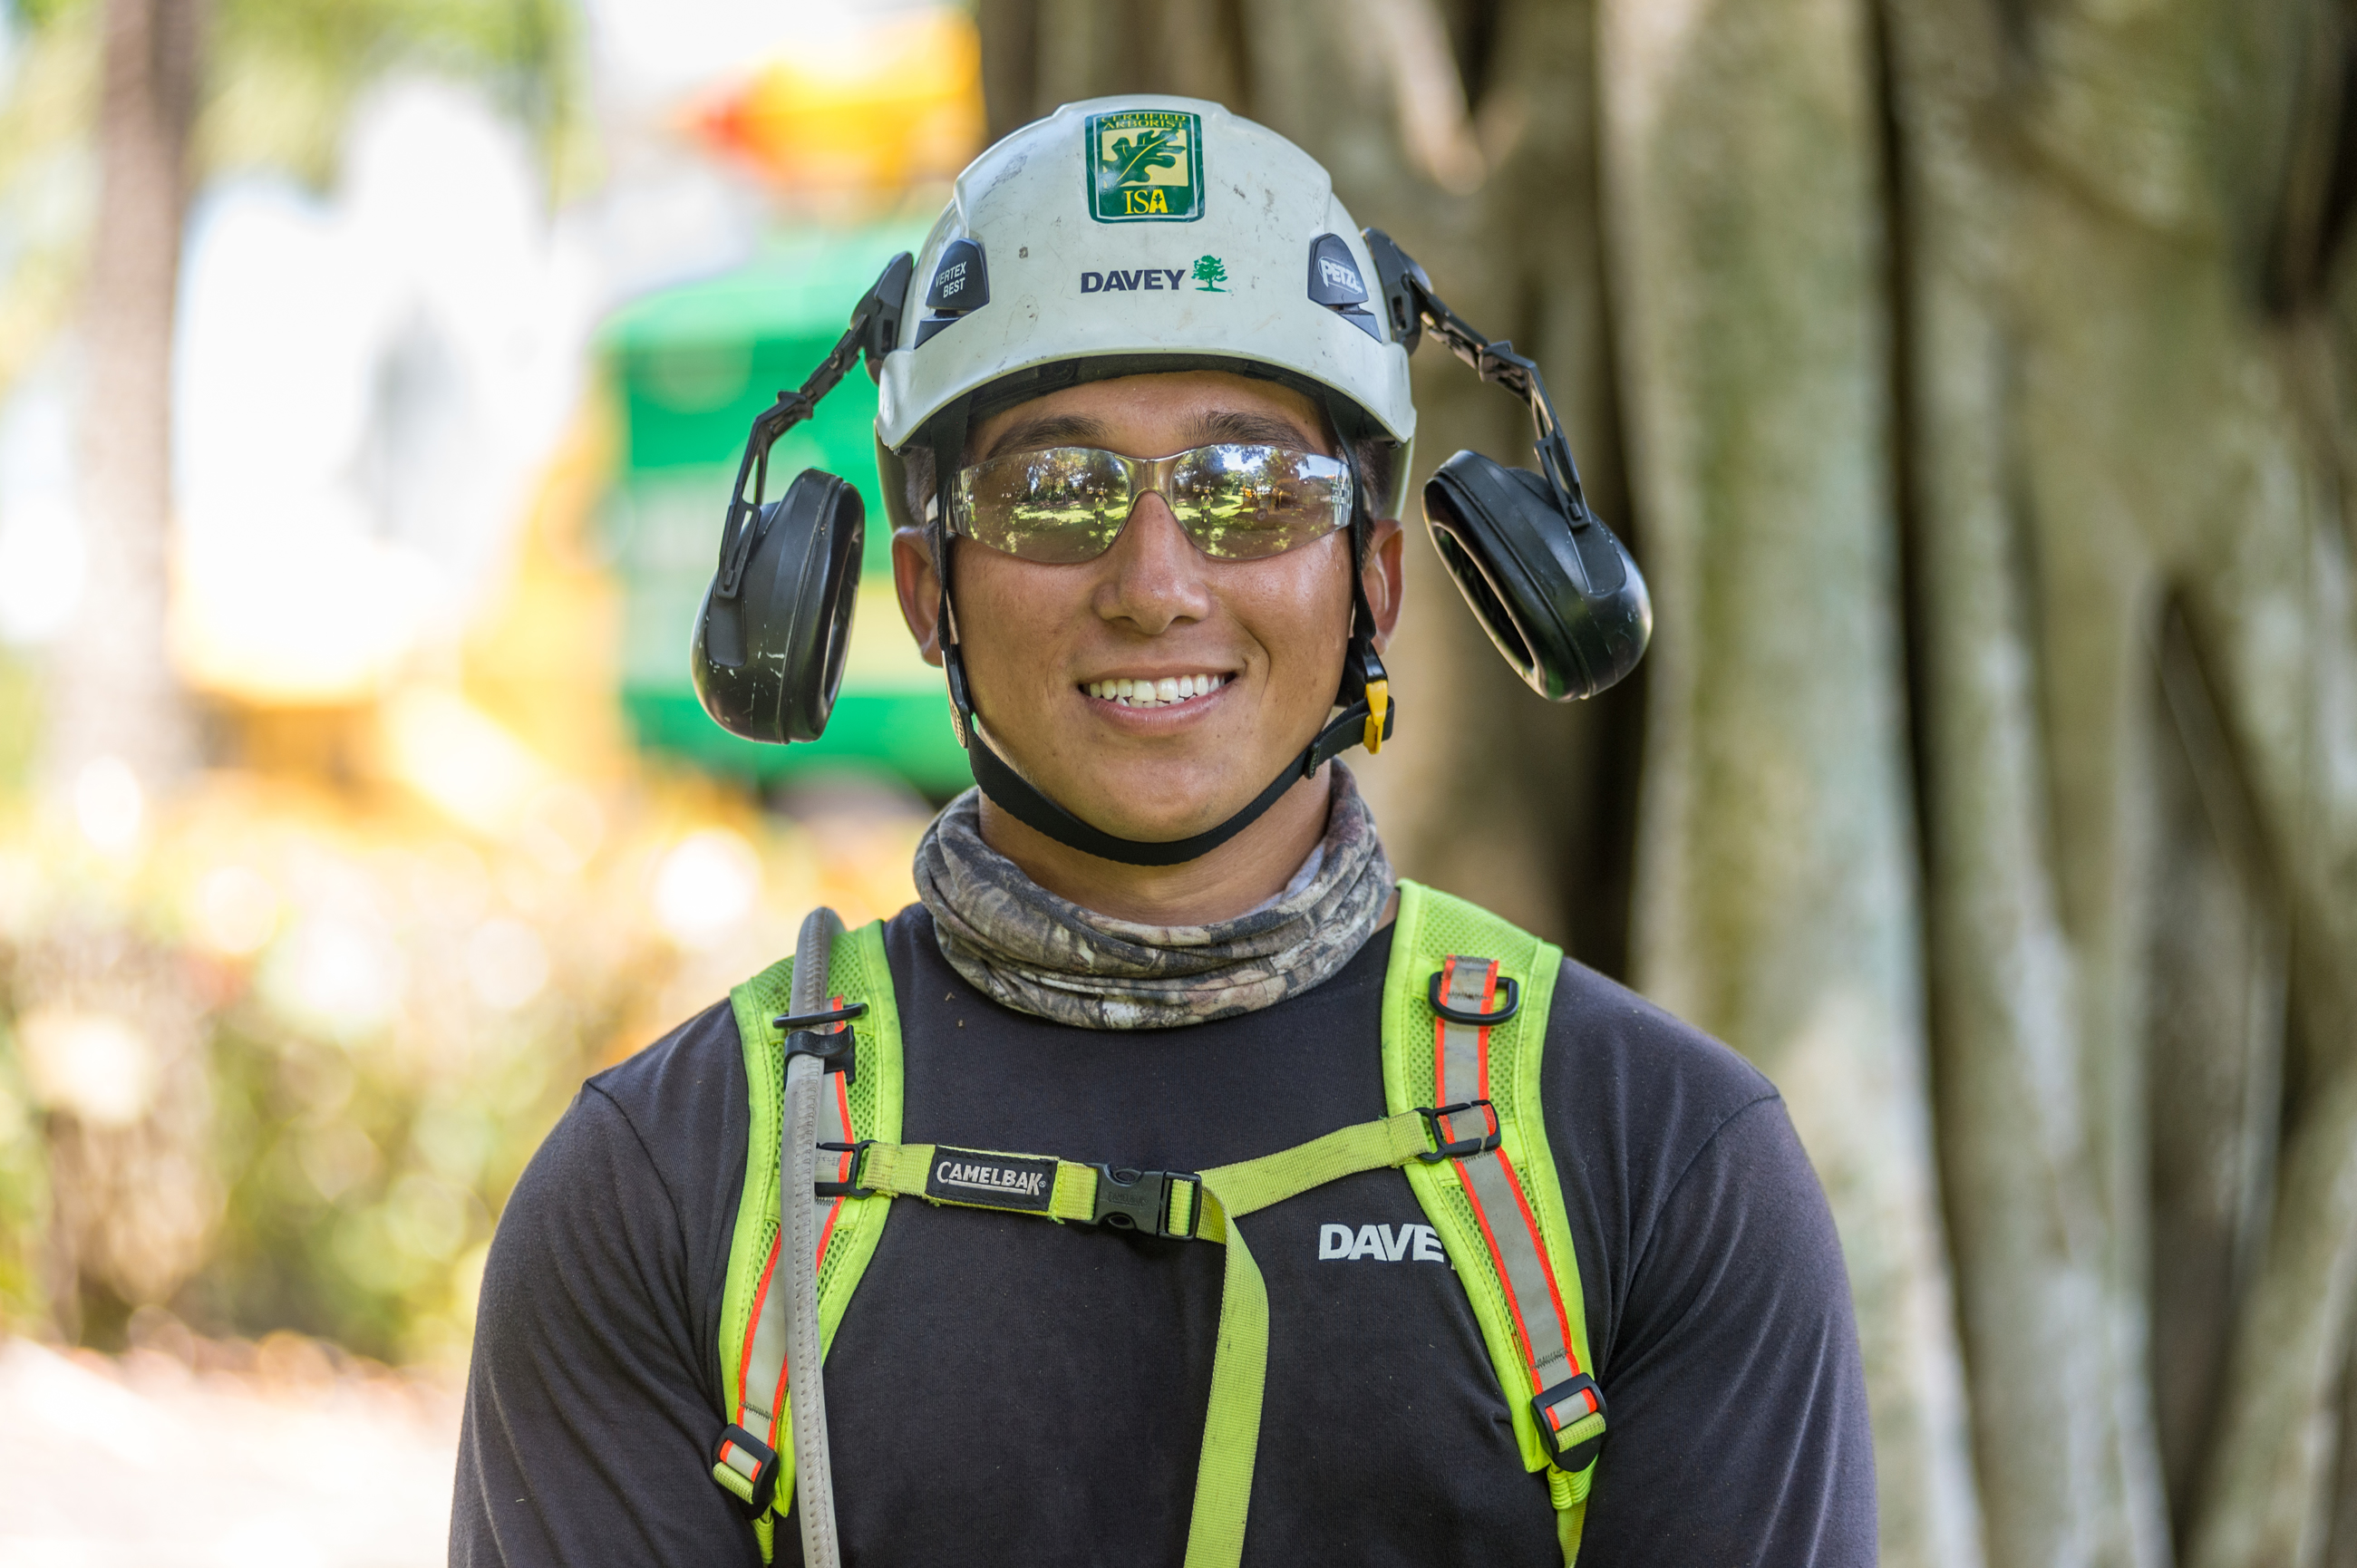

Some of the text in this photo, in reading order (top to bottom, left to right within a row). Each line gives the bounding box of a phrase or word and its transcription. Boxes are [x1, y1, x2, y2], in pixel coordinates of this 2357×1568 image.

[1103, 119, 1186, 130] ARBORIST
[1123, 189, 1169, 214] ISA
[936, 261, 967, 287] VERTEX
[1081, 269, 1186, 294] DAVEY
[1320, 259, 1363, 294] PETZL
[943, 277, 965, 298] BEST
[936, 1161, 1043, 1195] CAMELBAK
[1319, 1224, 1458, 1271] DAVE
